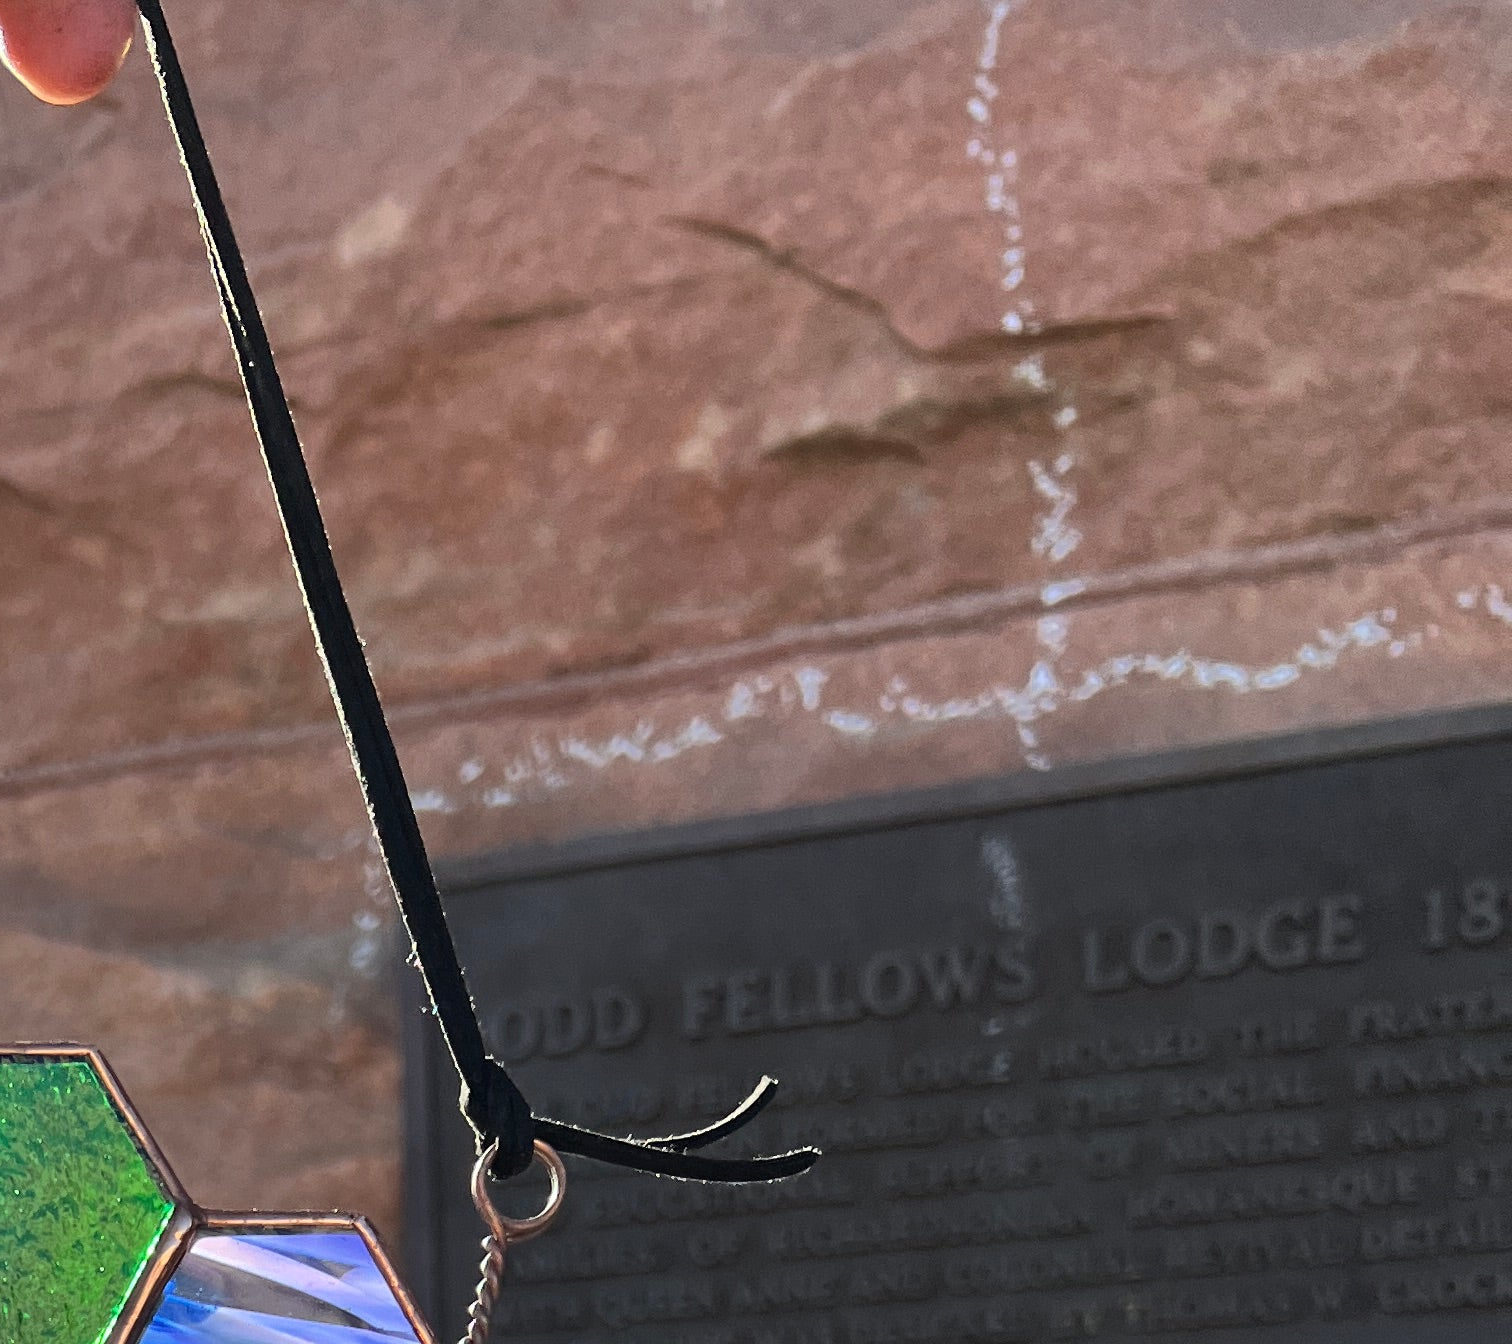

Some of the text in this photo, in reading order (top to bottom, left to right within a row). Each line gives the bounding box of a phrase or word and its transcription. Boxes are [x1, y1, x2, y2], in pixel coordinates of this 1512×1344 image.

[679, 933, 1033, 1040] FELLOWS
[1082, 891, 1364, 992] LODGE
[1418, 872, 1512, 952] 18
